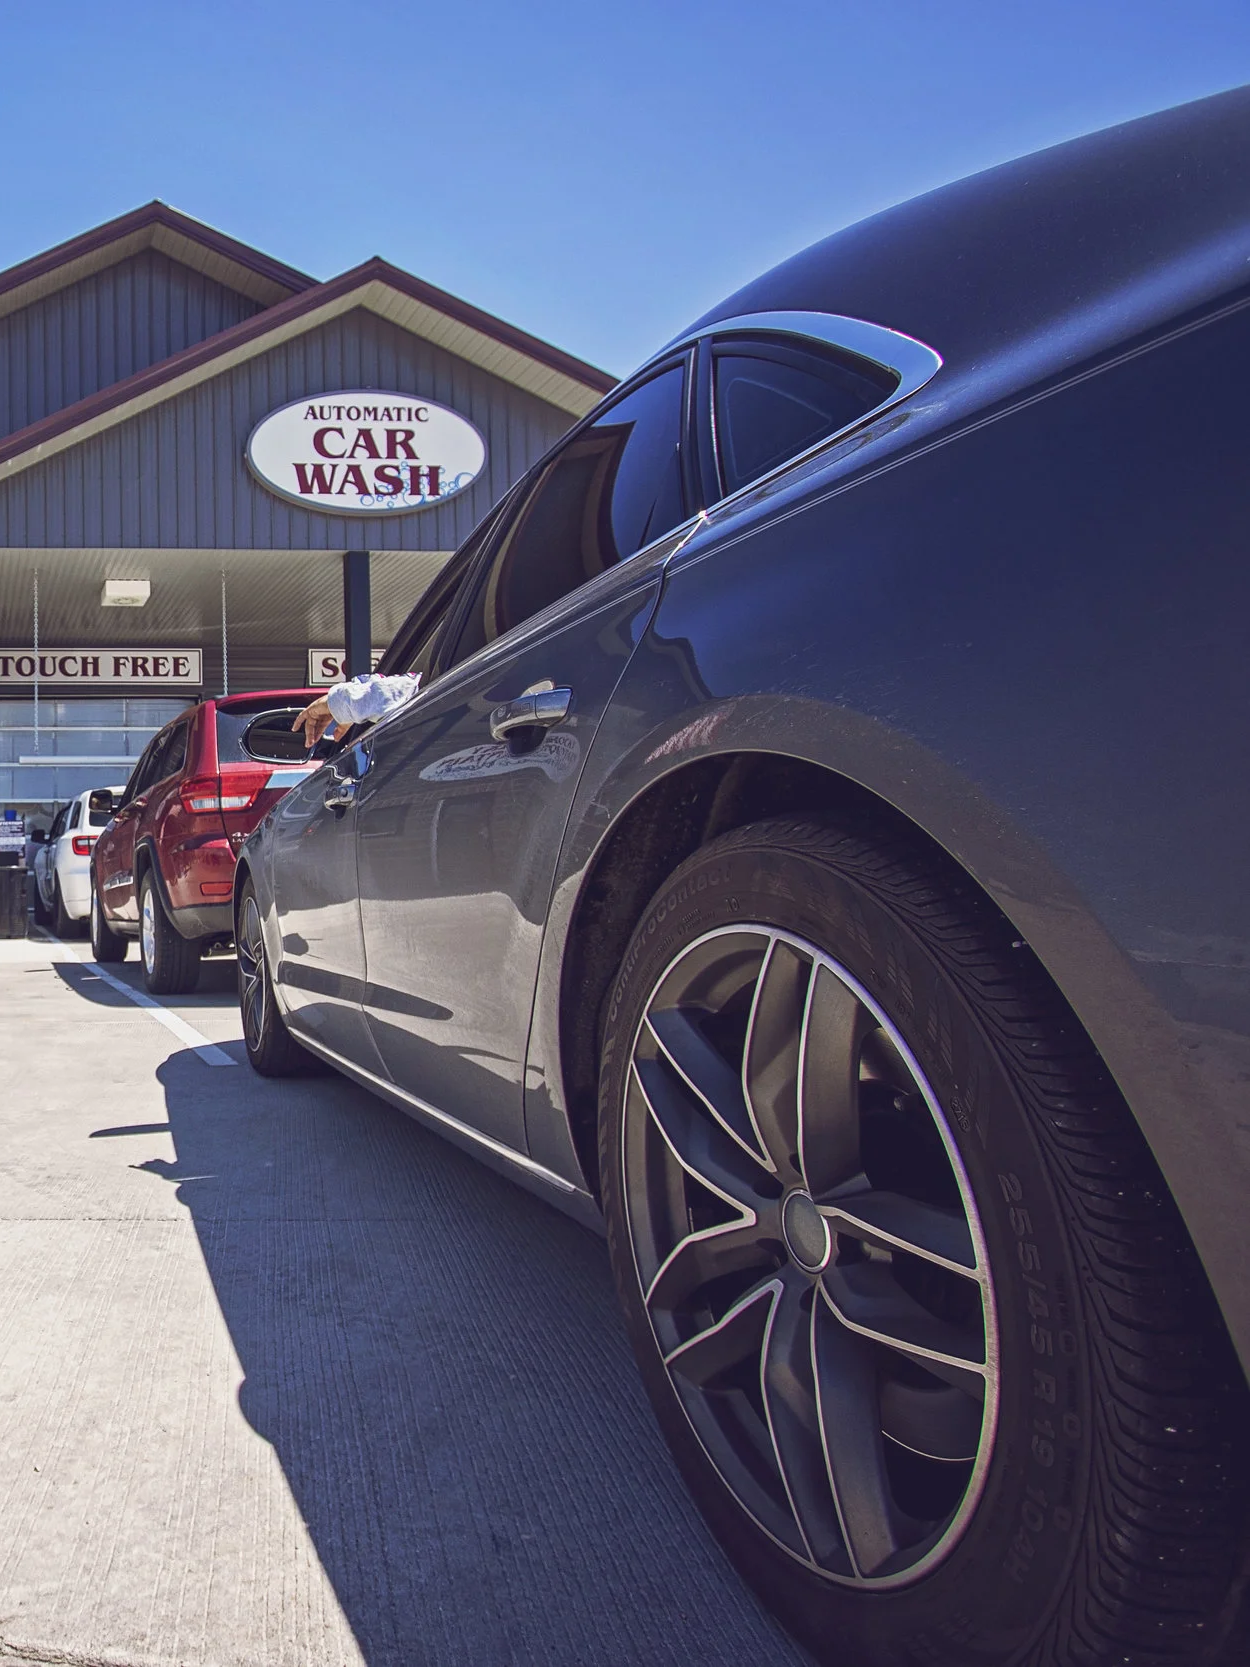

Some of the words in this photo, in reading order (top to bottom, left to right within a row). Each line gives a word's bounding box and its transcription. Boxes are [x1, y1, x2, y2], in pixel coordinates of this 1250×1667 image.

[303, 404, 430, 422] AUTOMATIC
[313, 427, 420, 460] CAR
[292, 462, 442, 497] WASH
[112, 655, 192, 678] FREE
[997, 1171, 1054, 1357] 255/45
[1031, 1367, 1057, 1405] R
[1030, 1417, 1056, 1468] 19
